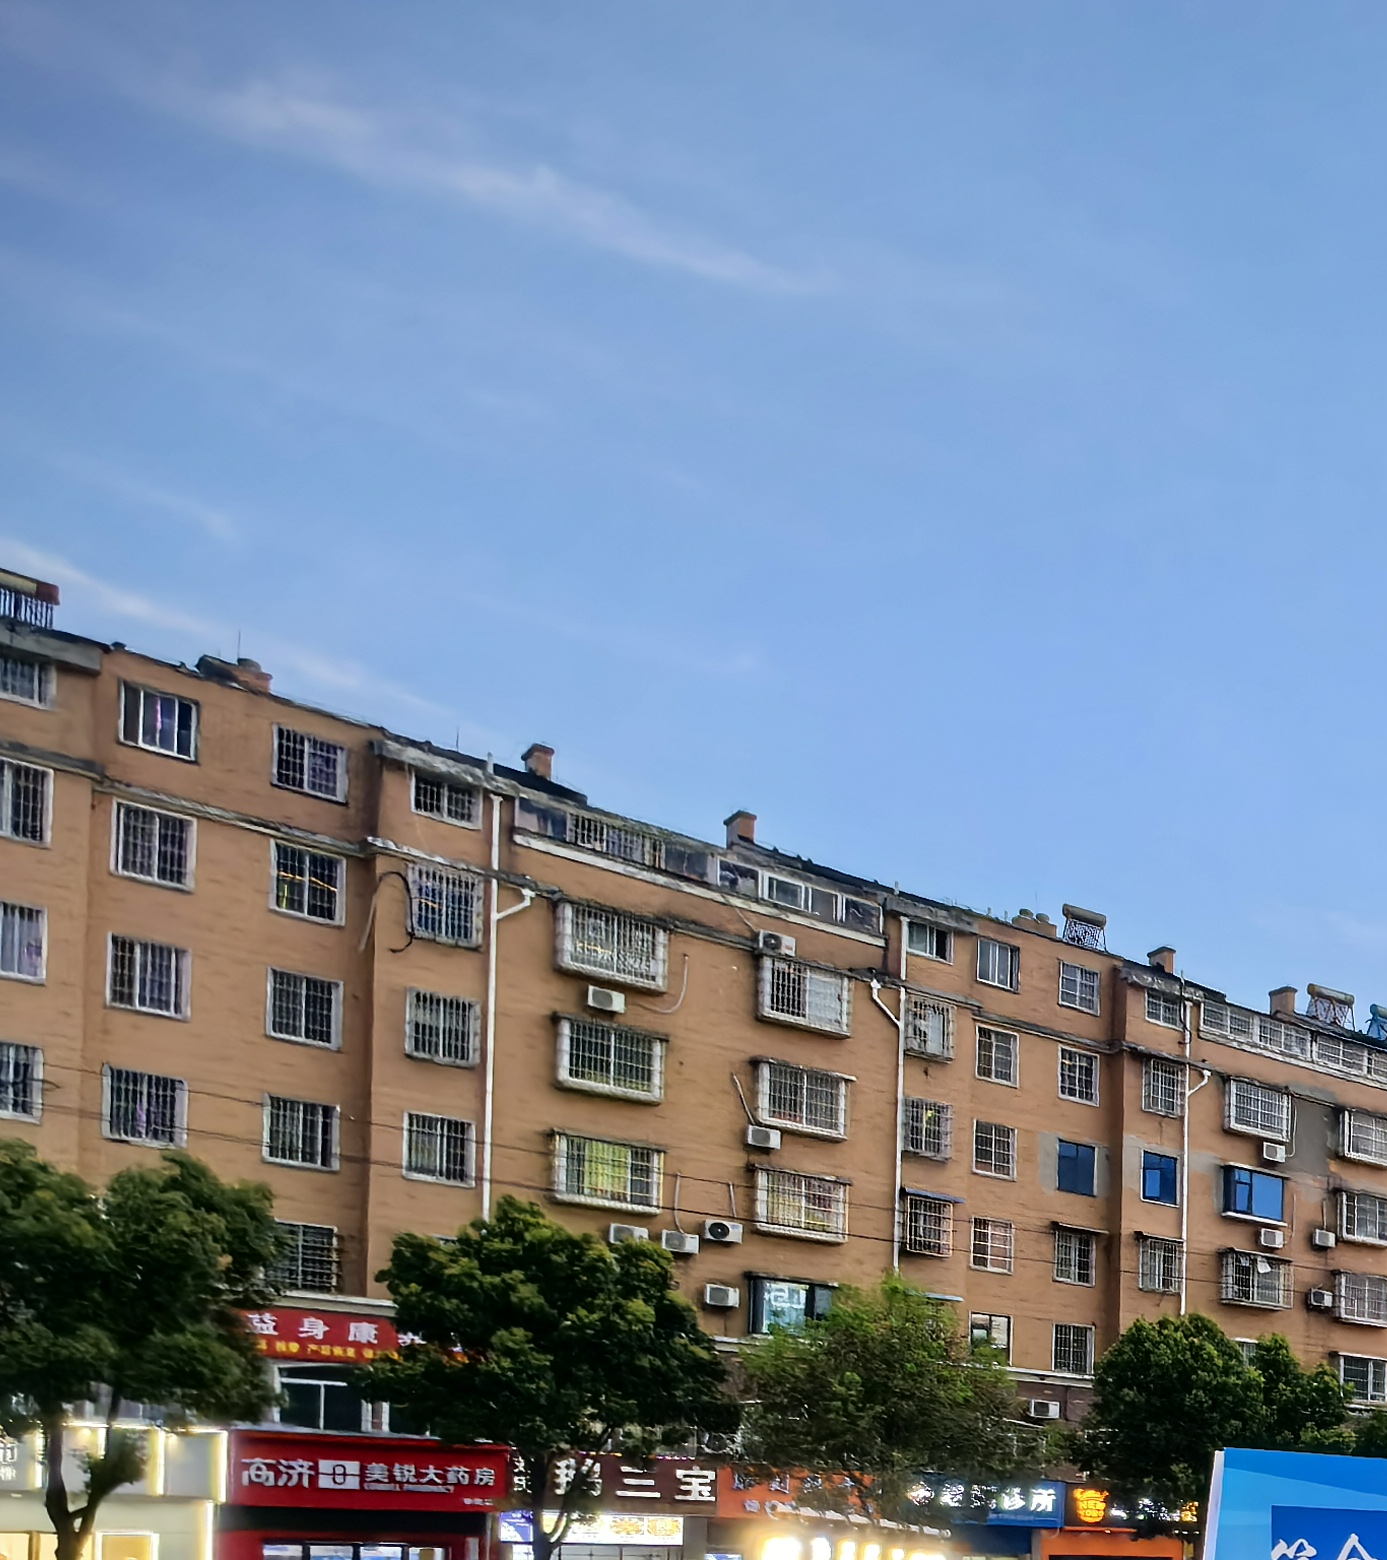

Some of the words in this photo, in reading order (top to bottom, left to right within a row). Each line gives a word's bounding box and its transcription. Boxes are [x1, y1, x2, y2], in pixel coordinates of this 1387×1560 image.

[241, 1457, 315, 1488] 高济
[365, 1462, 495, 1486] 美锐大药房
